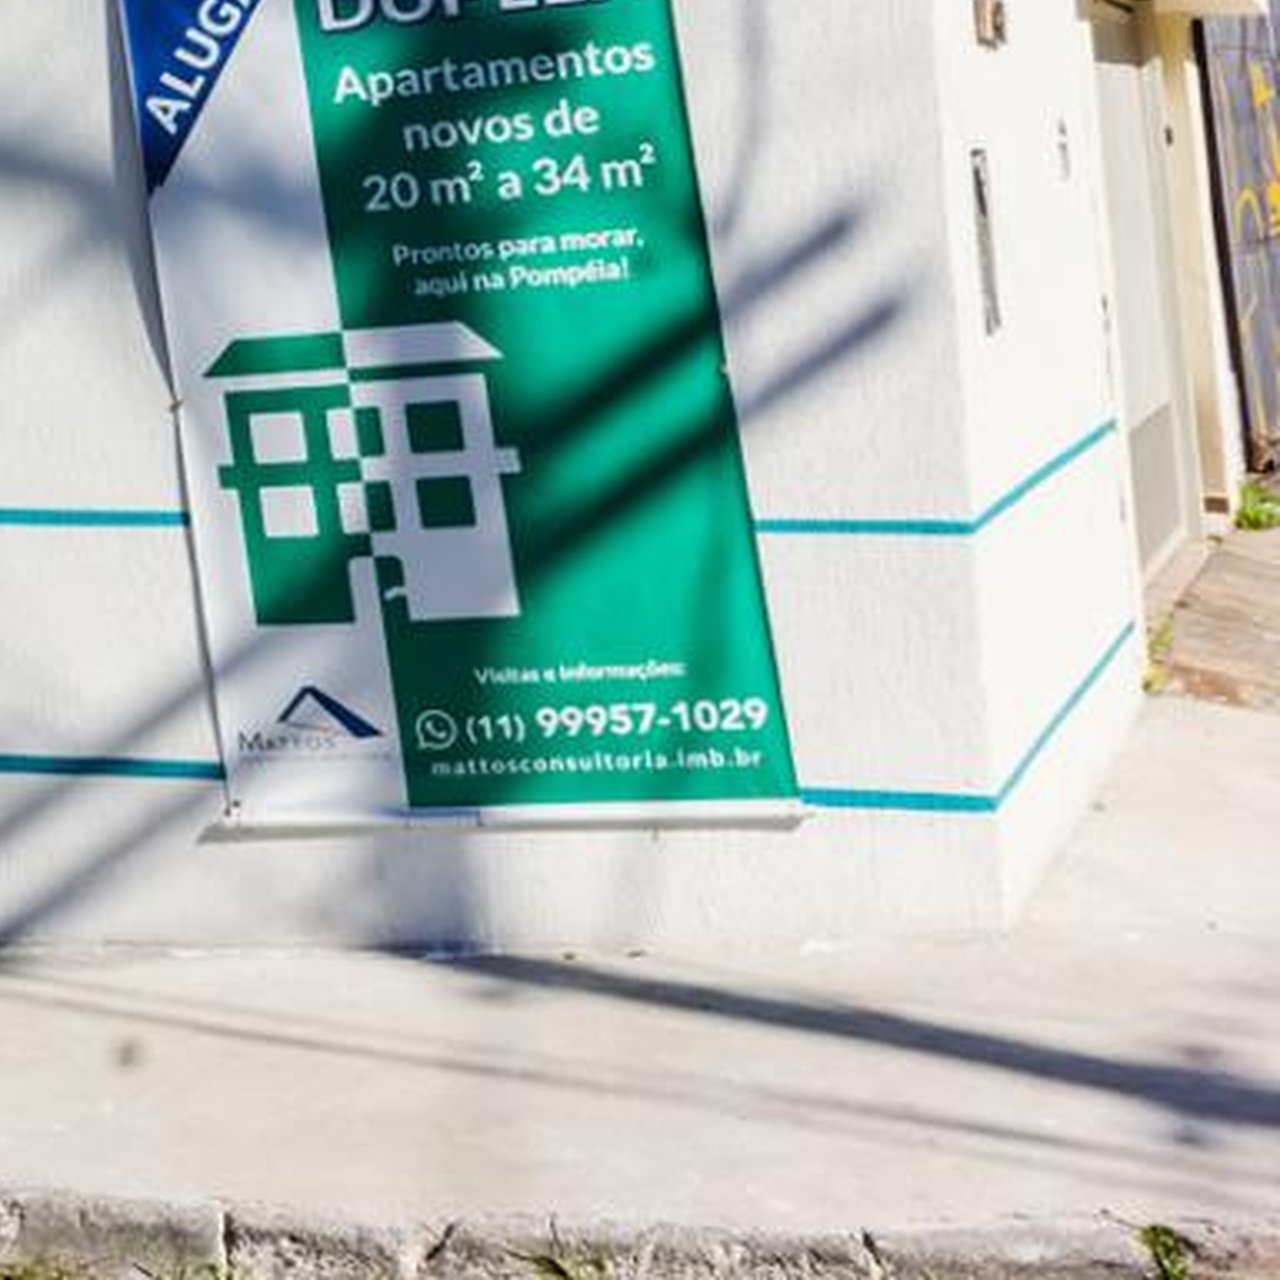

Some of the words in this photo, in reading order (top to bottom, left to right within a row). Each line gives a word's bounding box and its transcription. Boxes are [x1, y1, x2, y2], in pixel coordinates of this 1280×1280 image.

[334, 42, 656, 106] Apartamentos
[402, 112, 535, 151] novos
[543, 99, 600, 137] de
[362, 172, 420, 212] 20
[497, 170, 522, 200] a
[532, 155, 590, 195] 34
[393, 241, 494, 267] Prontos
[498, 234, 557, 261] para
[414, 272, 468, 297] aqui
[473, 273, 504, 291] na
[474, 666, 540, 685] Visitas
[543, 668, 557, 683] e
[465, 714, 526, 744] (11)
[535, 697, 769, 738] 99957-1029
[431, 748, 763, 776] mattosconsultoria.imb.br
